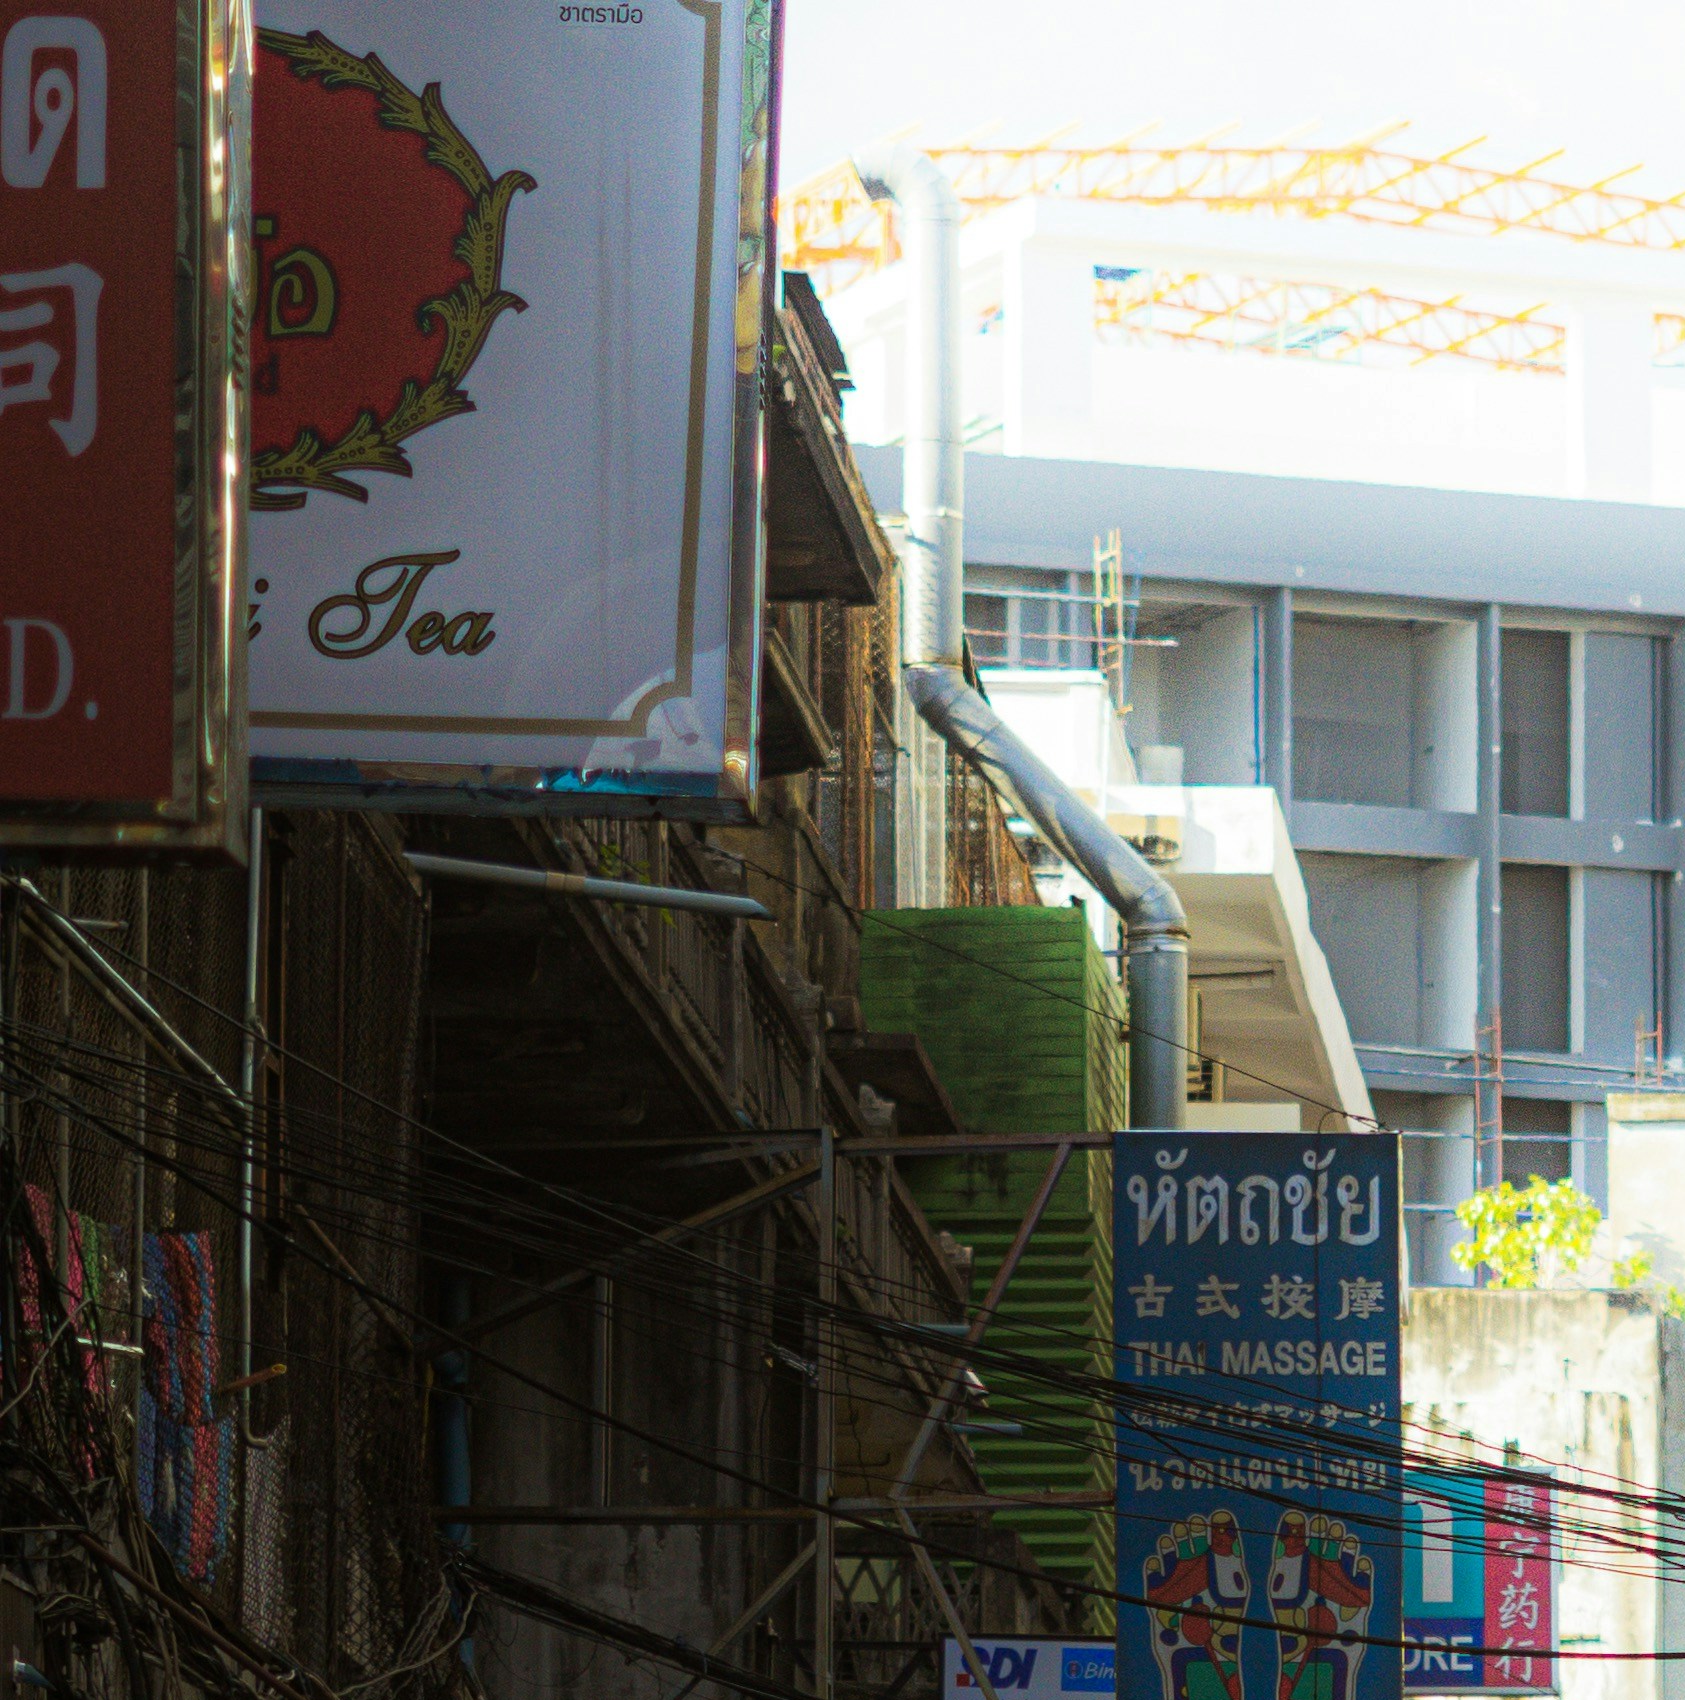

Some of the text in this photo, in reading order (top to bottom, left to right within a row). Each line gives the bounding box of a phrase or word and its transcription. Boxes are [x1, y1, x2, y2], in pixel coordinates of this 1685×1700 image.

[559, 4, 643, 24] ชาตรามือ
[307, 550, 496, 660] Tea
[1127, 1148, 1380, 1246] หัตถชัย
[1128, 1274, 1385, 1320] 古式按摩
[1128, 1341, 1387, 1377] THAI MASSAGE
